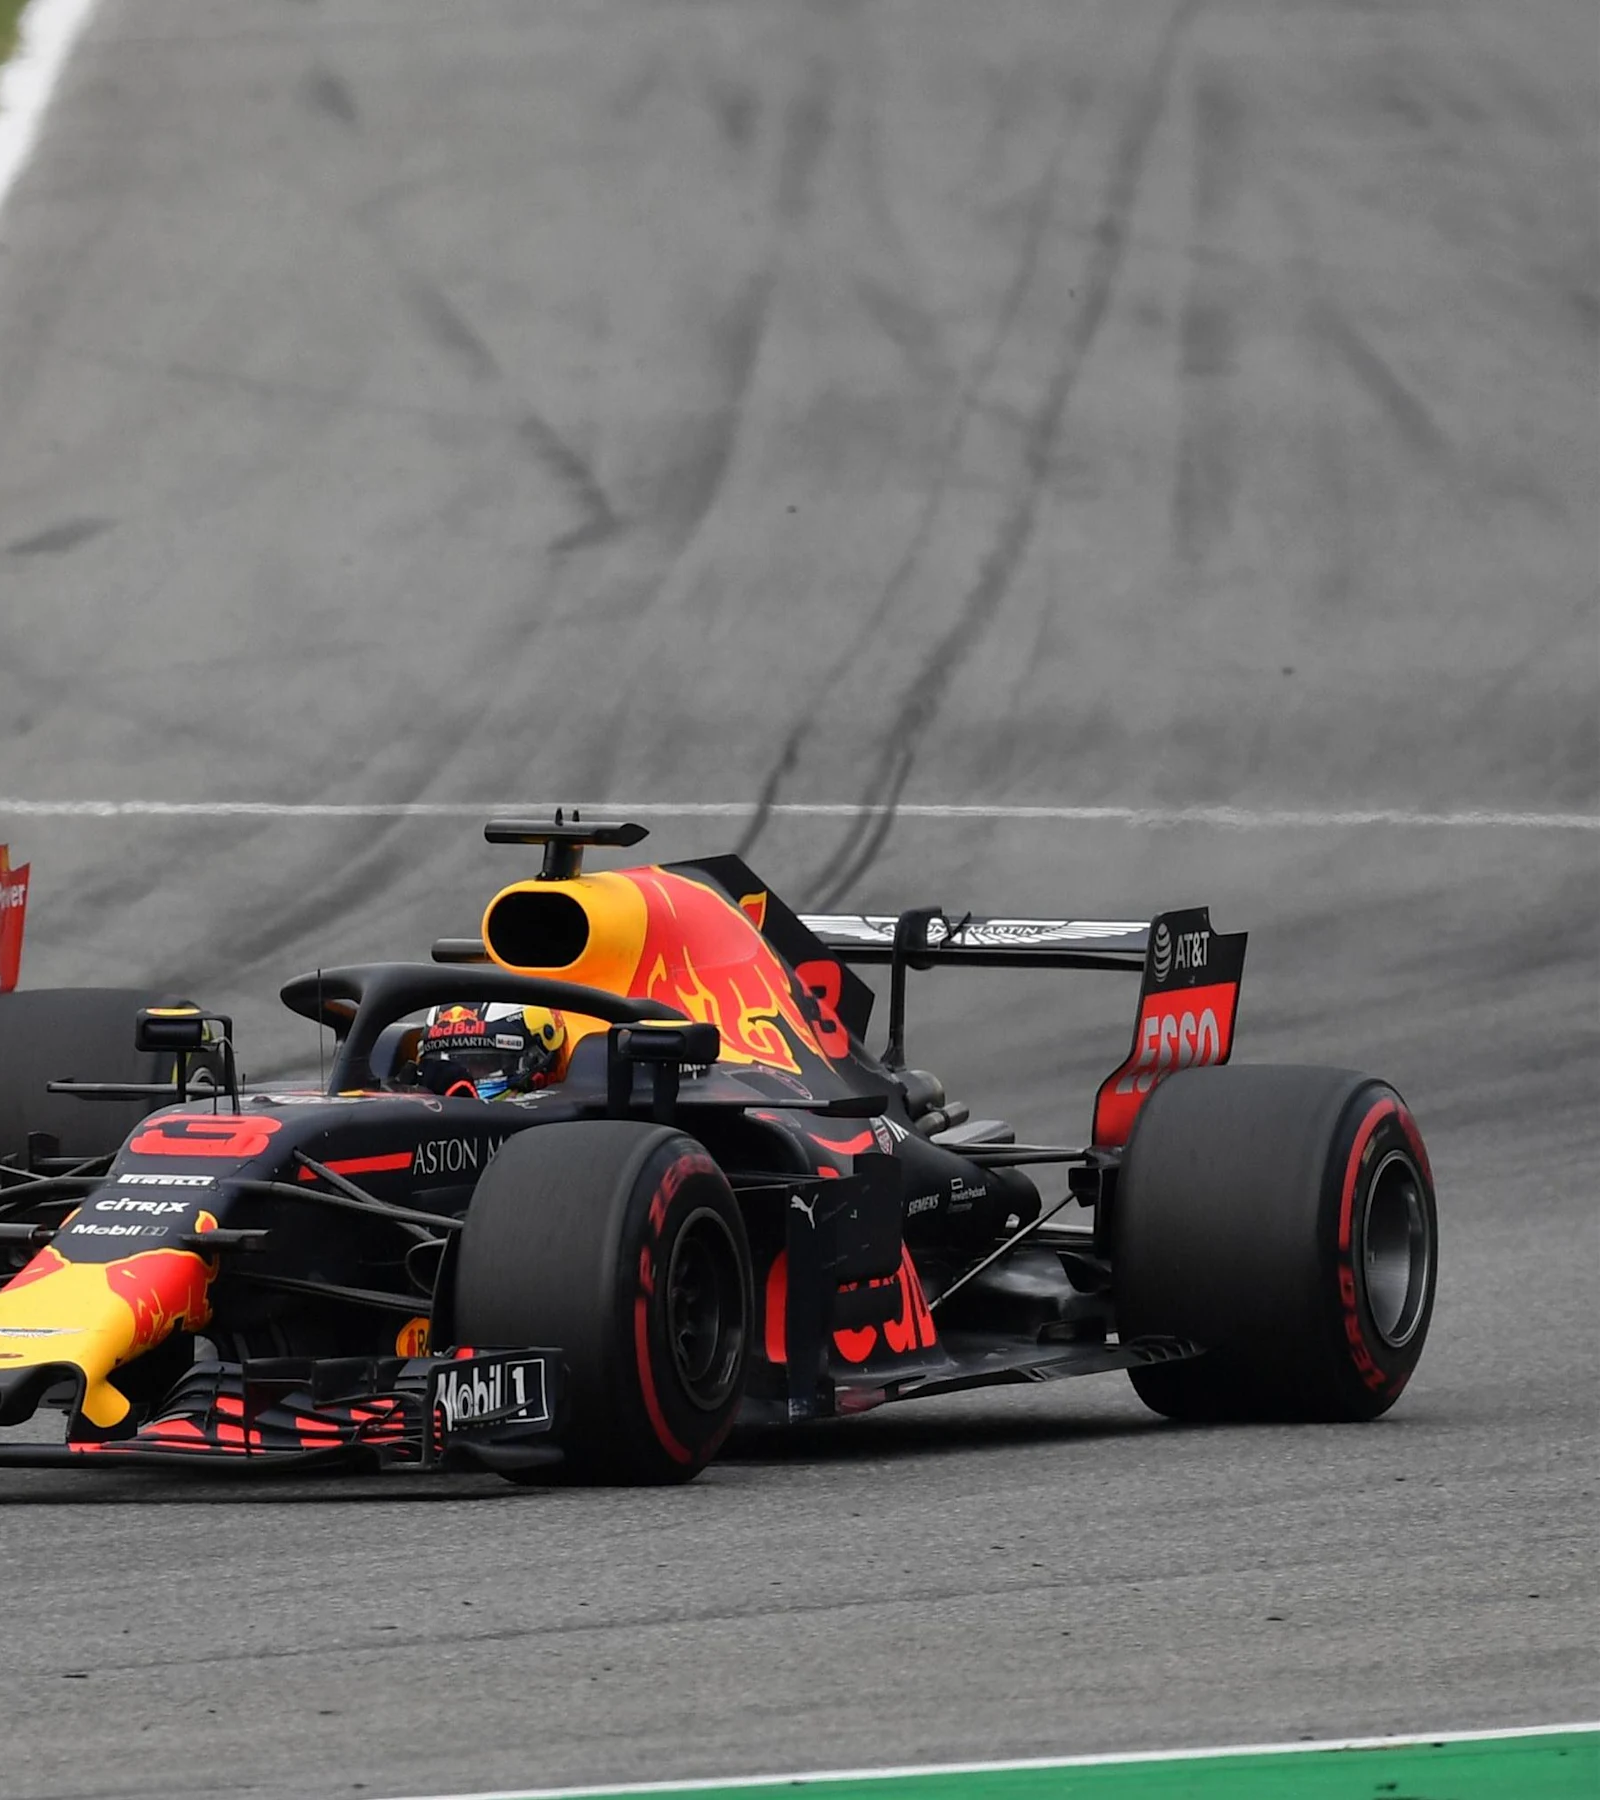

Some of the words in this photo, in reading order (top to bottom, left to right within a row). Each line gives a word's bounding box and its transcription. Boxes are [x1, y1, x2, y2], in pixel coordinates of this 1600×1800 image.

[1174, 931, 1210, 970] AT&T
[428, 1022, 454, 1039] Red
[455, 1020, 486, 1036] Bull
[451, 1036, 496, 1048] MARTIN
[129, 1114, 282, 1157] 3
[413, 1138, 478, 1175] ASTON
[117, 1174, 214, 1186] PIRELLI
[71, 1224, 142, 1236] Mobil
[433, 1364, 502, 1432] Mobil
